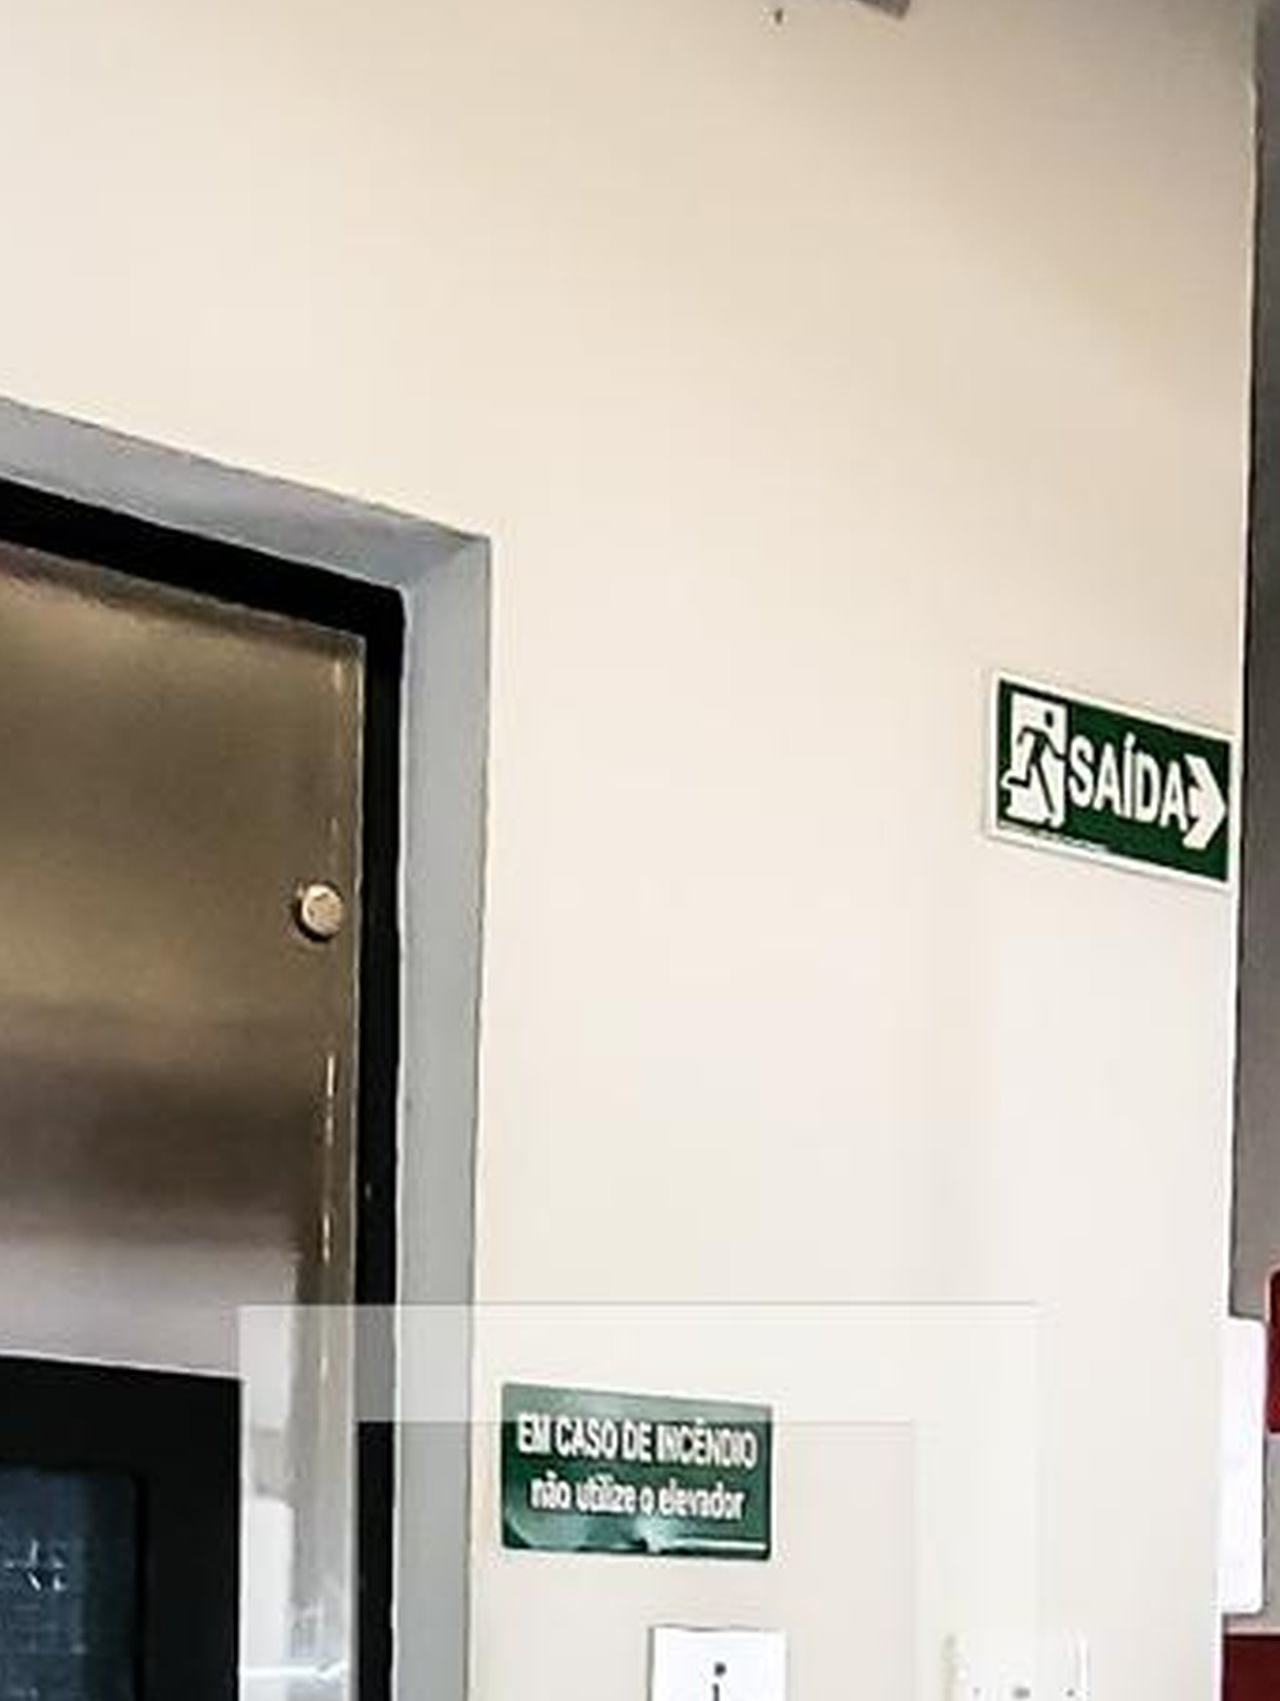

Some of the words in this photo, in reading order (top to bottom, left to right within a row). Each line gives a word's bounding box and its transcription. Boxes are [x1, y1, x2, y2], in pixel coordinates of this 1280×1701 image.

[1068, 730, 1188, 832] SAÍDA
[517, 1412, 551, 1454] EM
[555, 1415, 618, 1460] CASO
[622, 1418, 652, 1462] DE
[655, 1417, 757, 1468] INCÊNDIO
[530, 1470, 570, 1509] não
[575, 1473, 636, 1513] utilize
[639, 1485, 654, 1516] o
[658, 1477, 745, 1520] elevador
